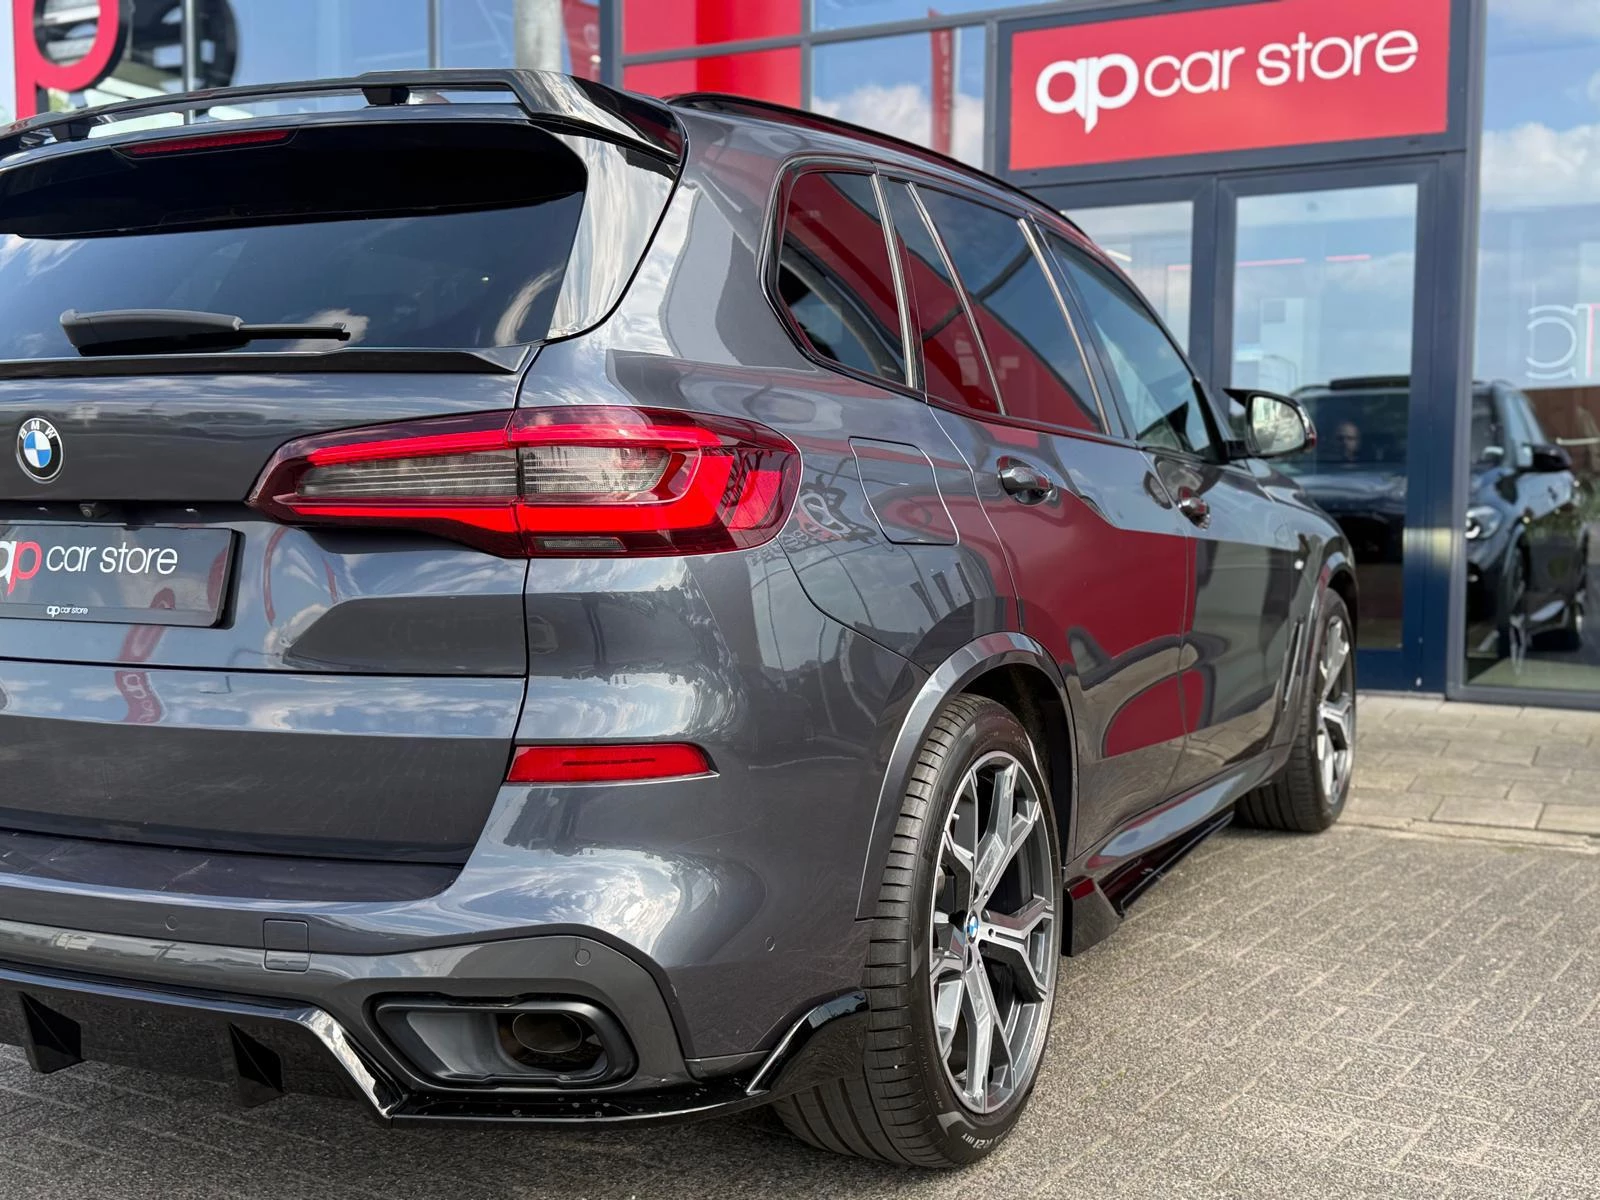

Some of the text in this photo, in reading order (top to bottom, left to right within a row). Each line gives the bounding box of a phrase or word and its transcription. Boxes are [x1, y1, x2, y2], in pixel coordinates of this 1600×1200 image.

[1036, 29, 1419, 134] ap car store
[20, 420, 57, 440] BMW
[46, 545, 97, 572] car
[99, 541, 178, 575] store
[46, 605, 89, 618] ap car store
